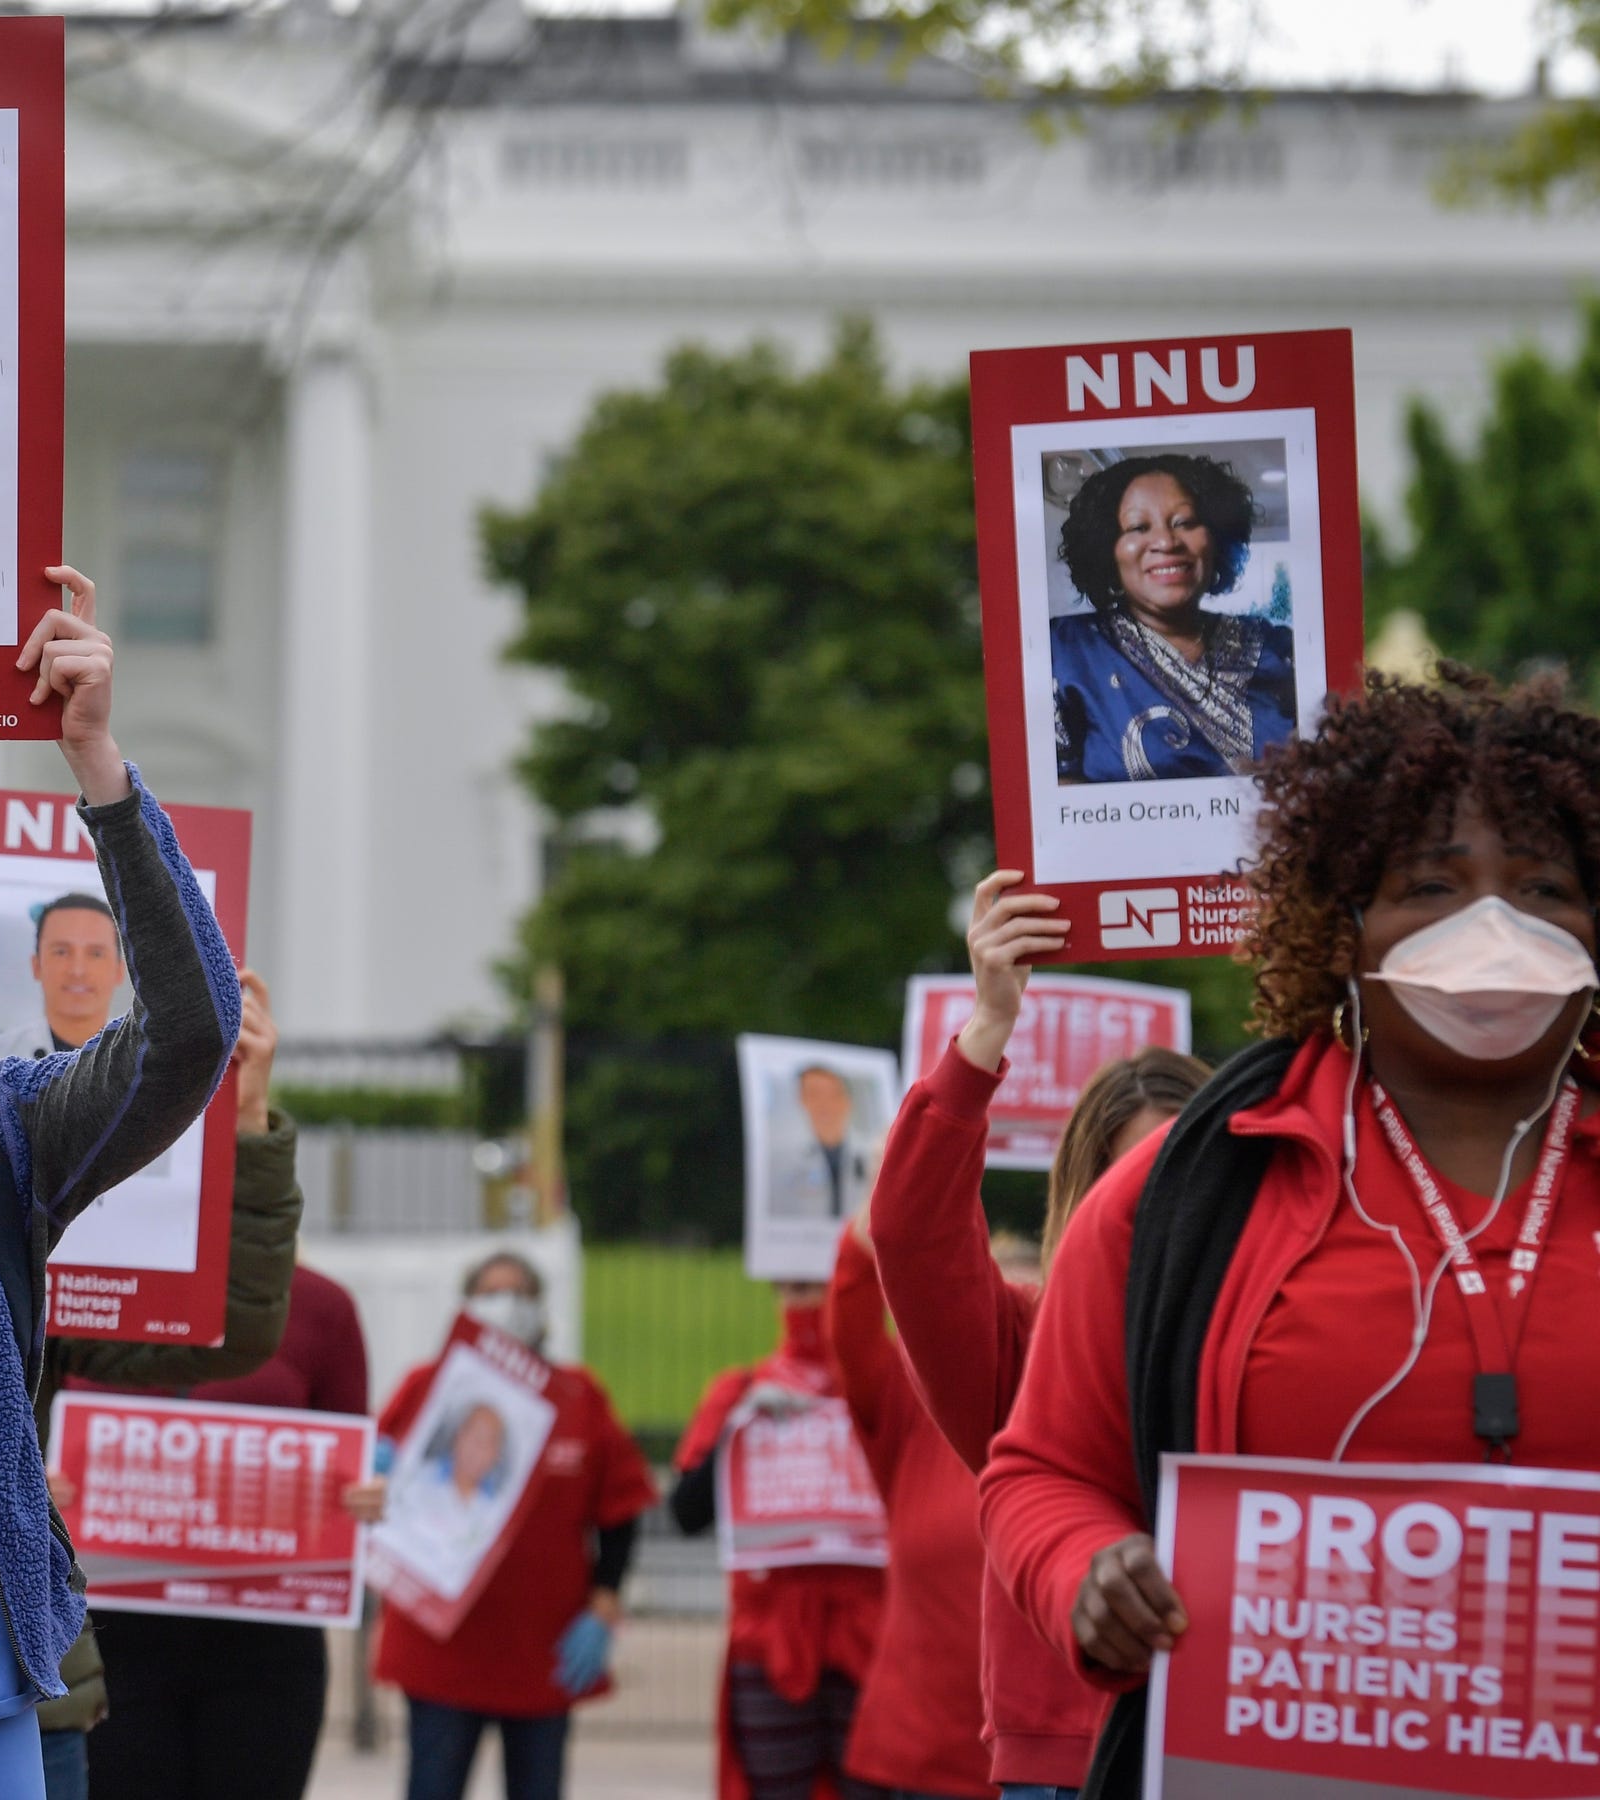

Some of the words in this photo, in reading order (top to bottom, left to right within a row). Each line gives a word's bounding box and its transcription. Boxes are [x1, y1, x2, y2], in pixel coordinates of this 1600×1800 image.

[1065, 344, 1257, 412] NNU
[1060, 803, 1121, 825] Freda
[1129, 801, 1202, 821] Ocran,
[1209, 797, 1241, 816] RN
[55, 1291, 122, 1312] Nurses
[56, 1272, 138, 1295] National
[55, 1309, 119, 1330] United
[88, 1412, 339, 1473] PROTECT
[81, 1517, 182, 1547] PUBLIC
[187, 1525, 297, 1556] HEALTH
[1230, 1594, 1458, 1652] NURSES
[1227, 1645, 1503, 1706] PATIENTS
[1225, 1696, 1431, 1751] PUBLIC
[1446, 1713, 1600, 1766] HEAL
